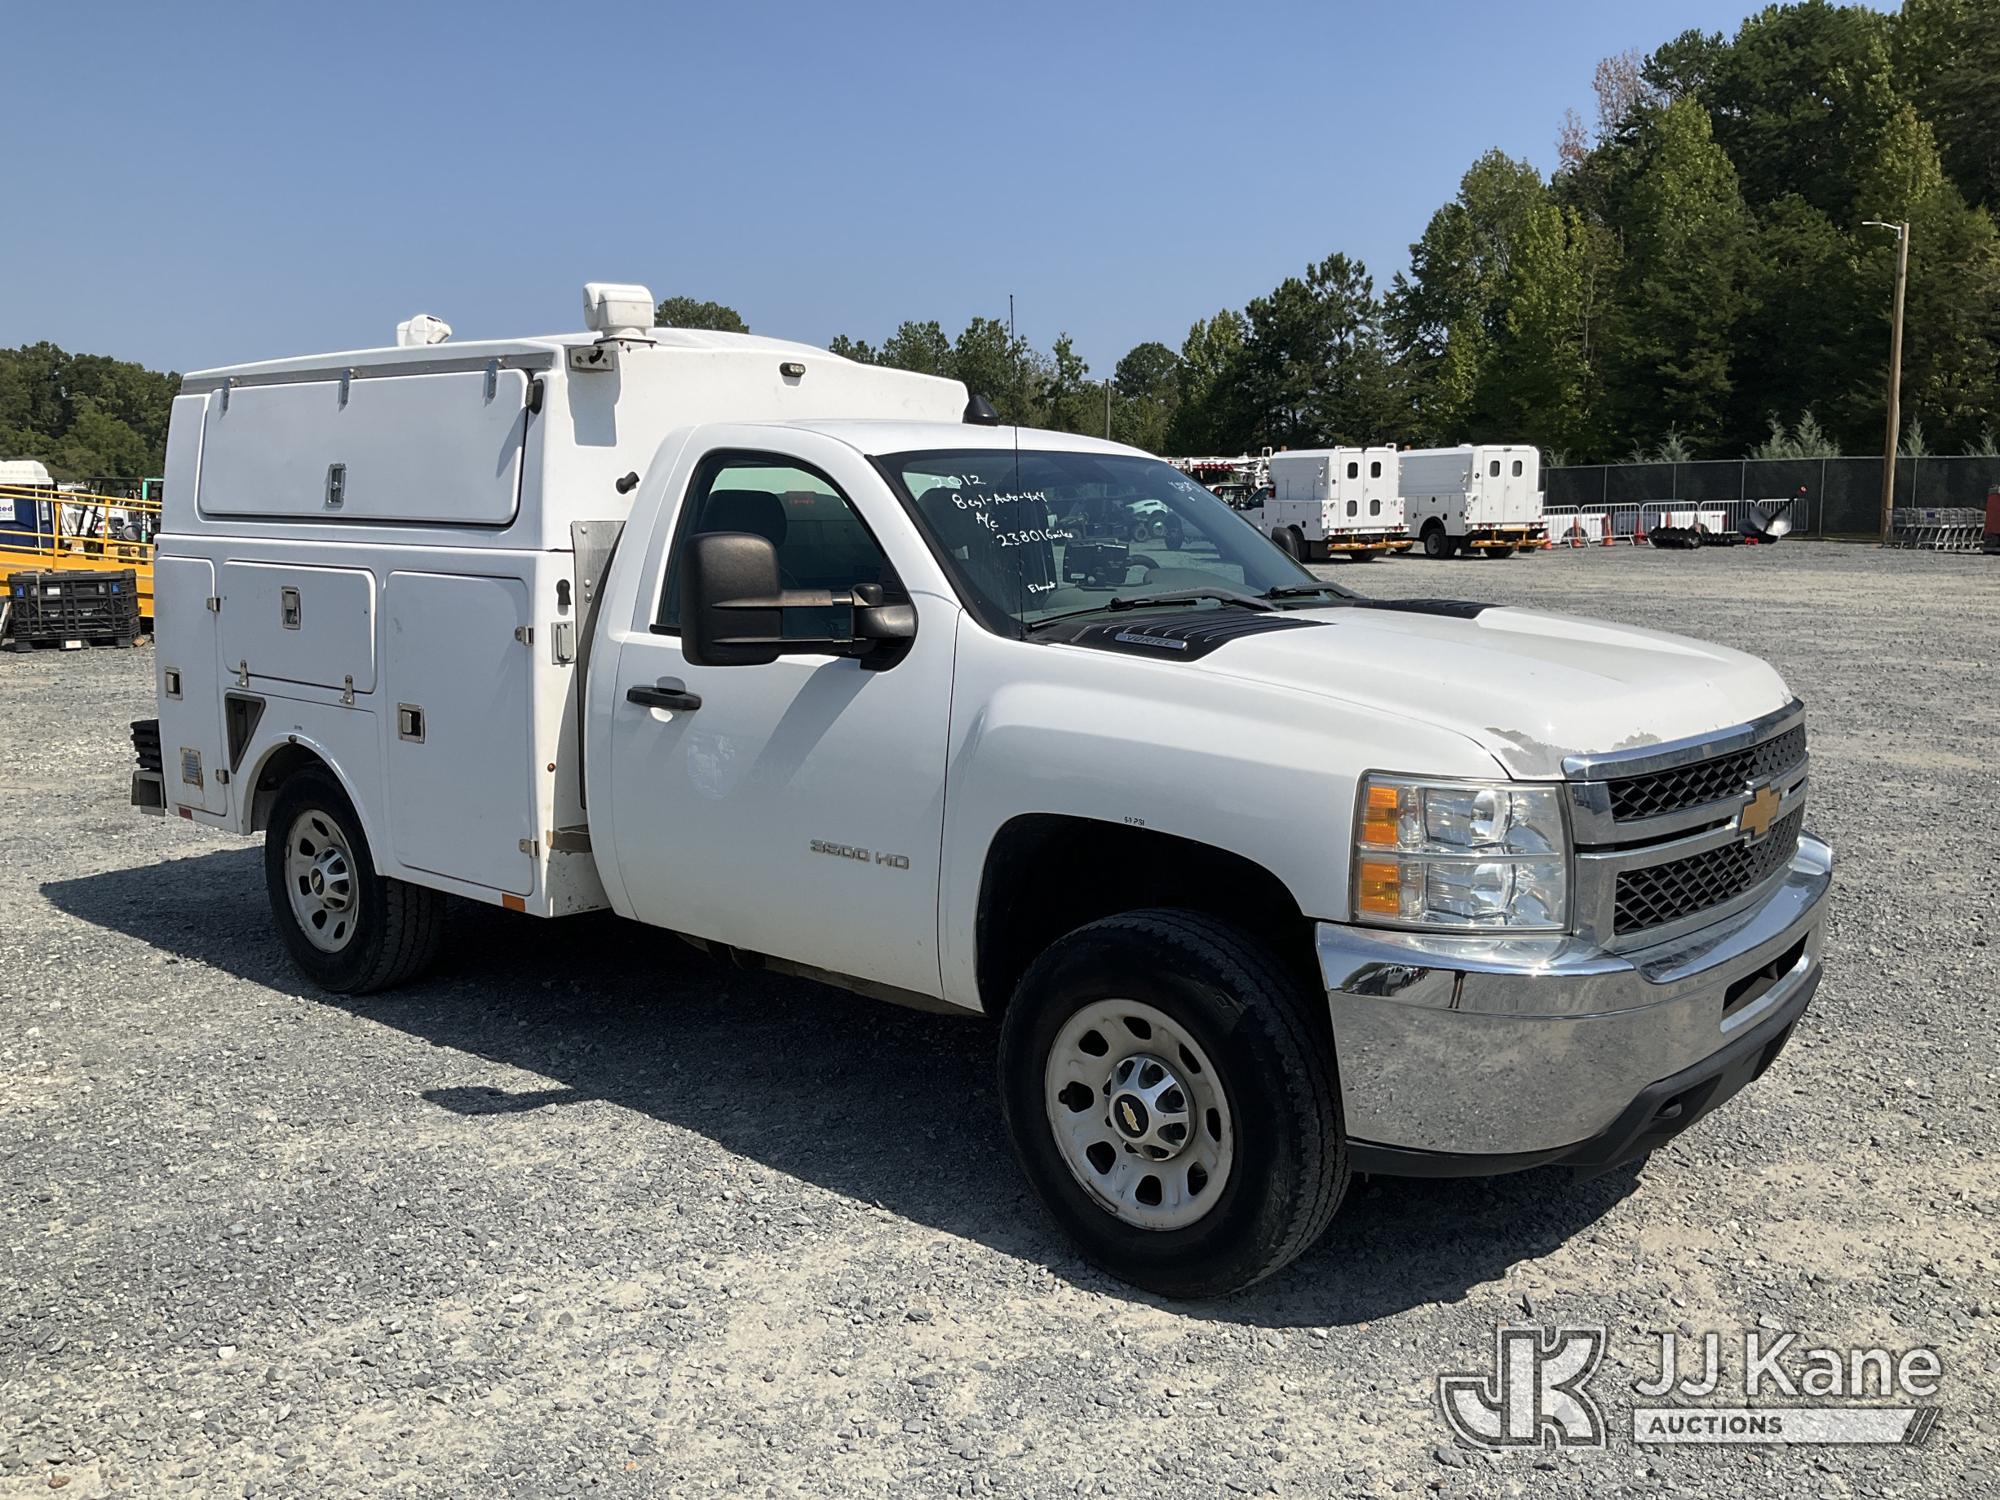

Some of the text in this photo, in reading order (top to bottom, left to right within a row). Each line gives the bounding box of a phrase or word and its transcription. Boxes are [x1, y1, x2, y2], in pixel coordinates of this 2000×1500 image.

[931, 475, 986, 488] 2012
[1125, 634, 1174, 647] VORTEC
[810, 839, 910, 870] 3500 HD
